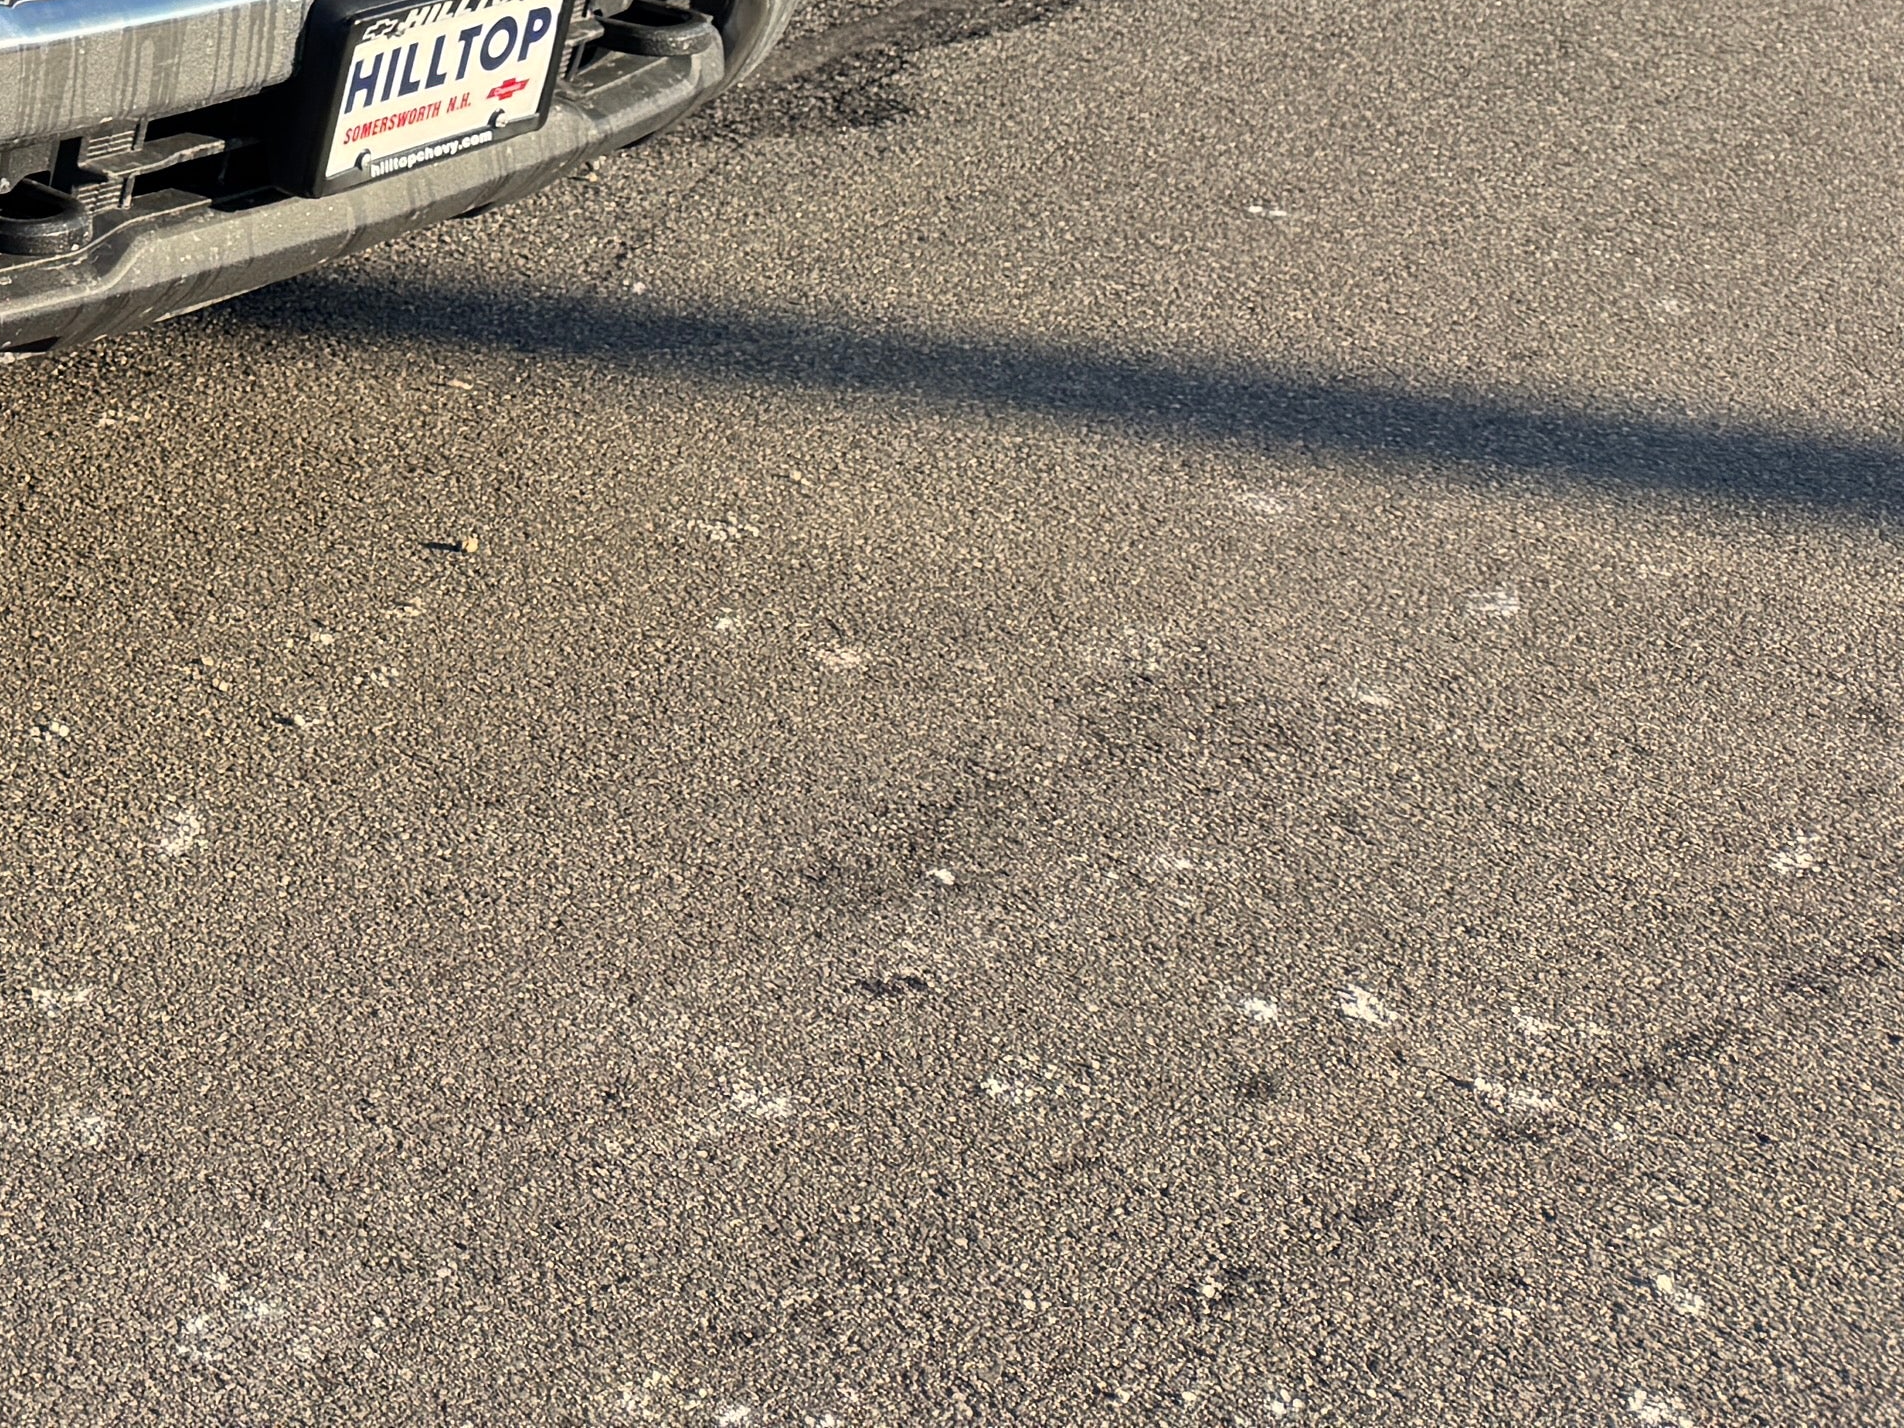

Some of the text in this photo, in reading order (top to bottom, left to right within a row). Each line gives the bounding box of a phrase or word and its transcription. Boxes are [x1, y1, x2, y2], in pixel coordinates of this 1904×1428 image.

[344, 7, 552, 114] HILLTOP
[344, 92, 472, 144] SOMERSWORTH N.H.
[371, 130, 493, 178] hilltopchevy.com
